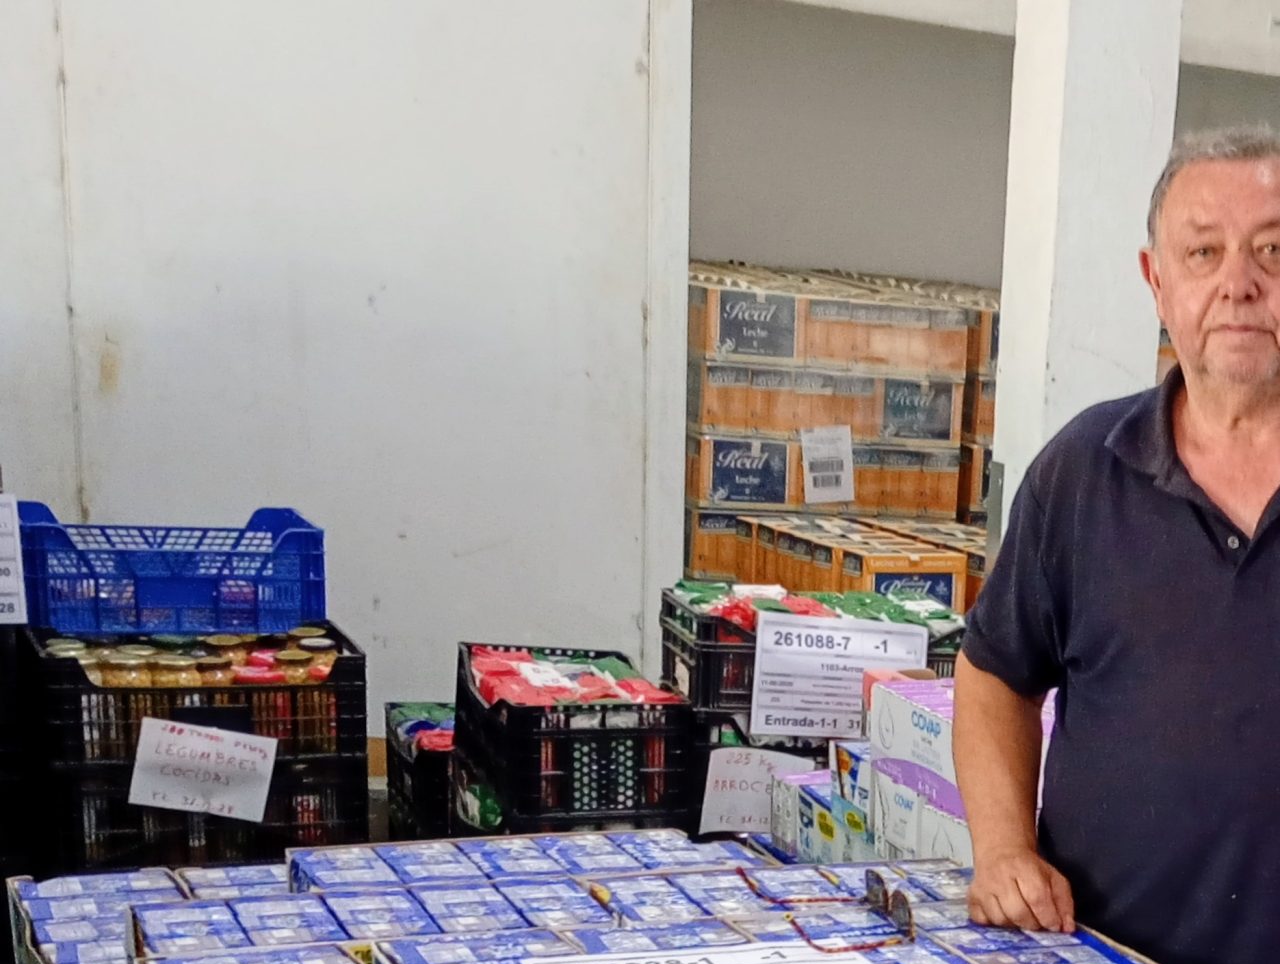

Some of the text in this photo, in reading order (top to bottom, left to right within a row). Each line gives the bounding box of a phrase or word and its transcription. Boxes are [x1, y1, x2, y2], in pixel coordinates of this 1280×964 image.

[723, 301, 777, 322] Real
[716, 450, 769, 469] Real
[774, 631, 889, 654] 261088-7 -1
[765, 715, 837, 729] Entrada-1-1
[155, 742, 257, 772] LEGUMBRES
[160, 765, 230, 786] COCIDAS
[760, 951, 787, 960] -1
